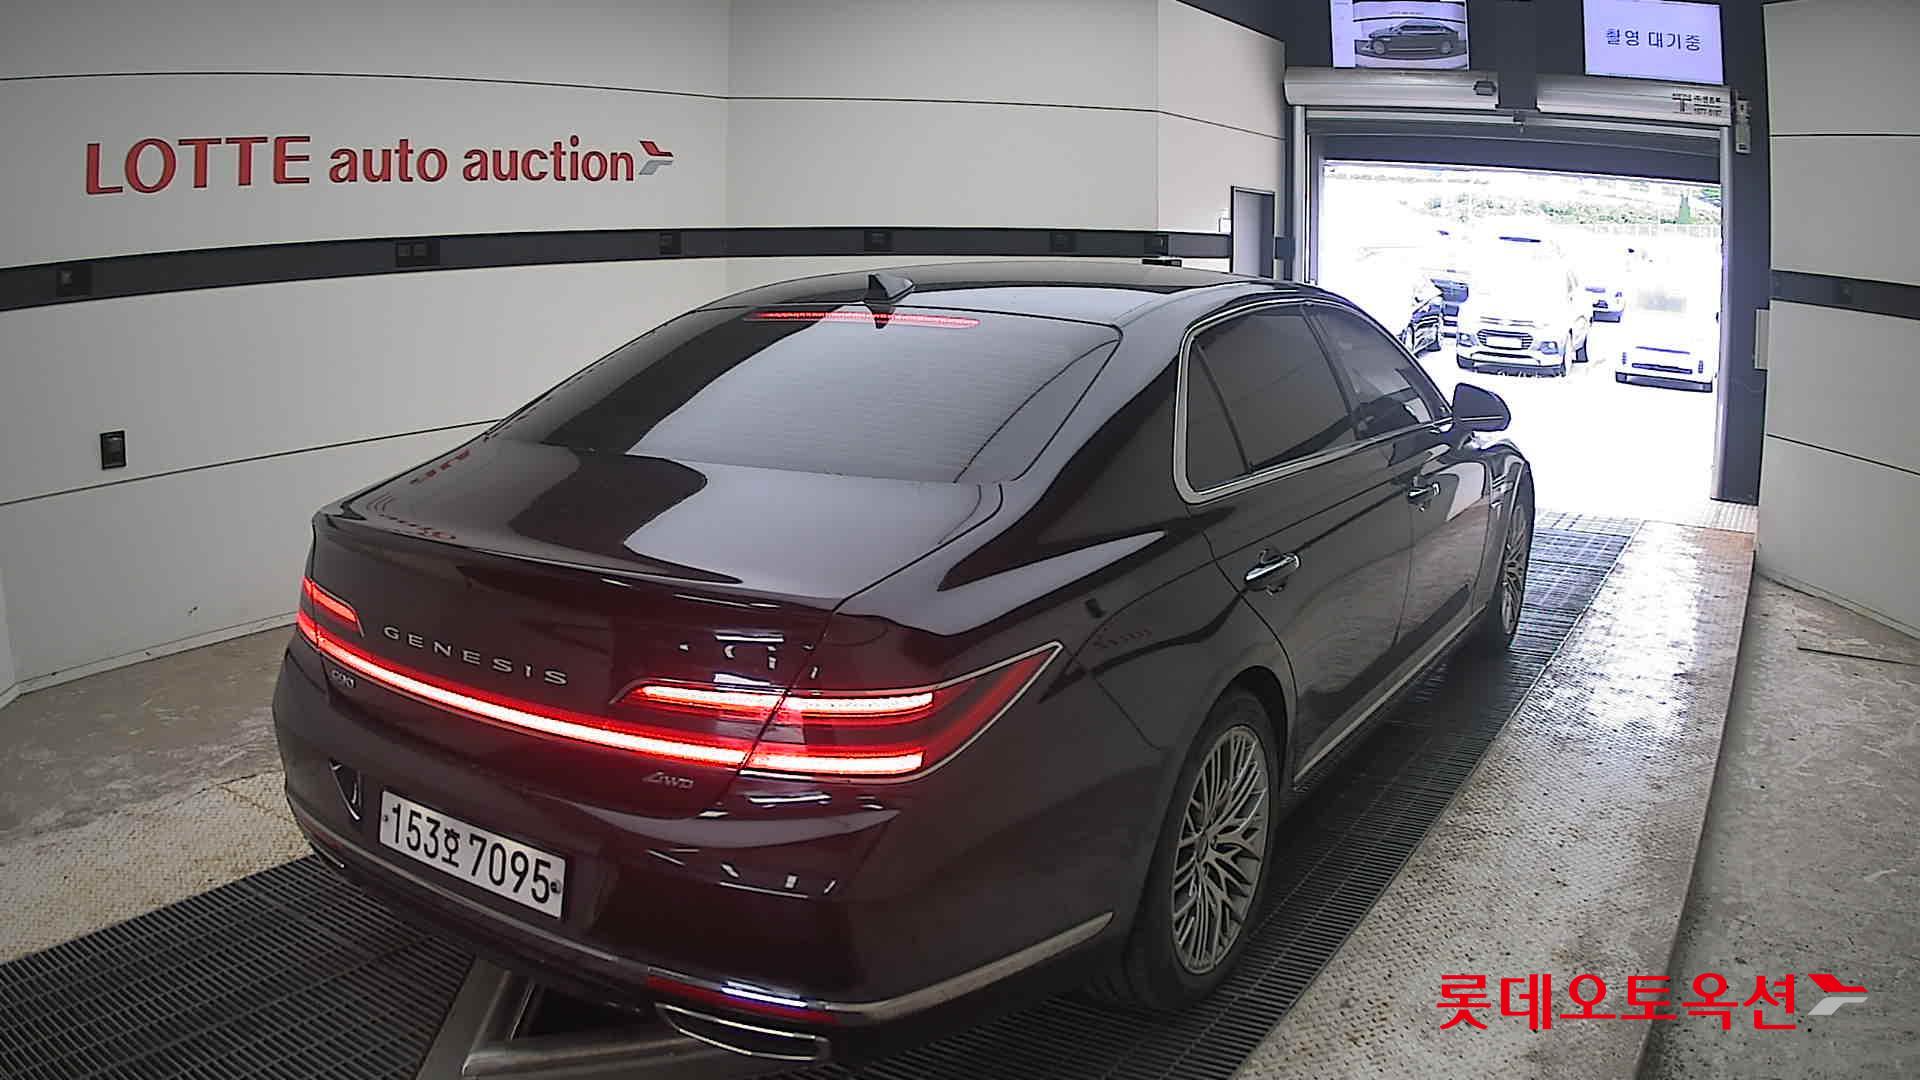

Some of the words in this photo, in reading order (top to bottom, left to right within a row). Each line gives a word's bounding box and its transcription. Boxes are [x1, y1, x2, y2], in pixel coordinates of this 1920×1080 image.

[1648, 31, 1701, 52] 대기중
[85, 135, 311, 195] LOTTE
[328, 138, 448, 183] auto
[462, 135, 635, 182] auction
[383, 625, 569, 687] GENESIS
[392, 803, 461, 869] 153호
[468, 832, 552, 905] 7095
